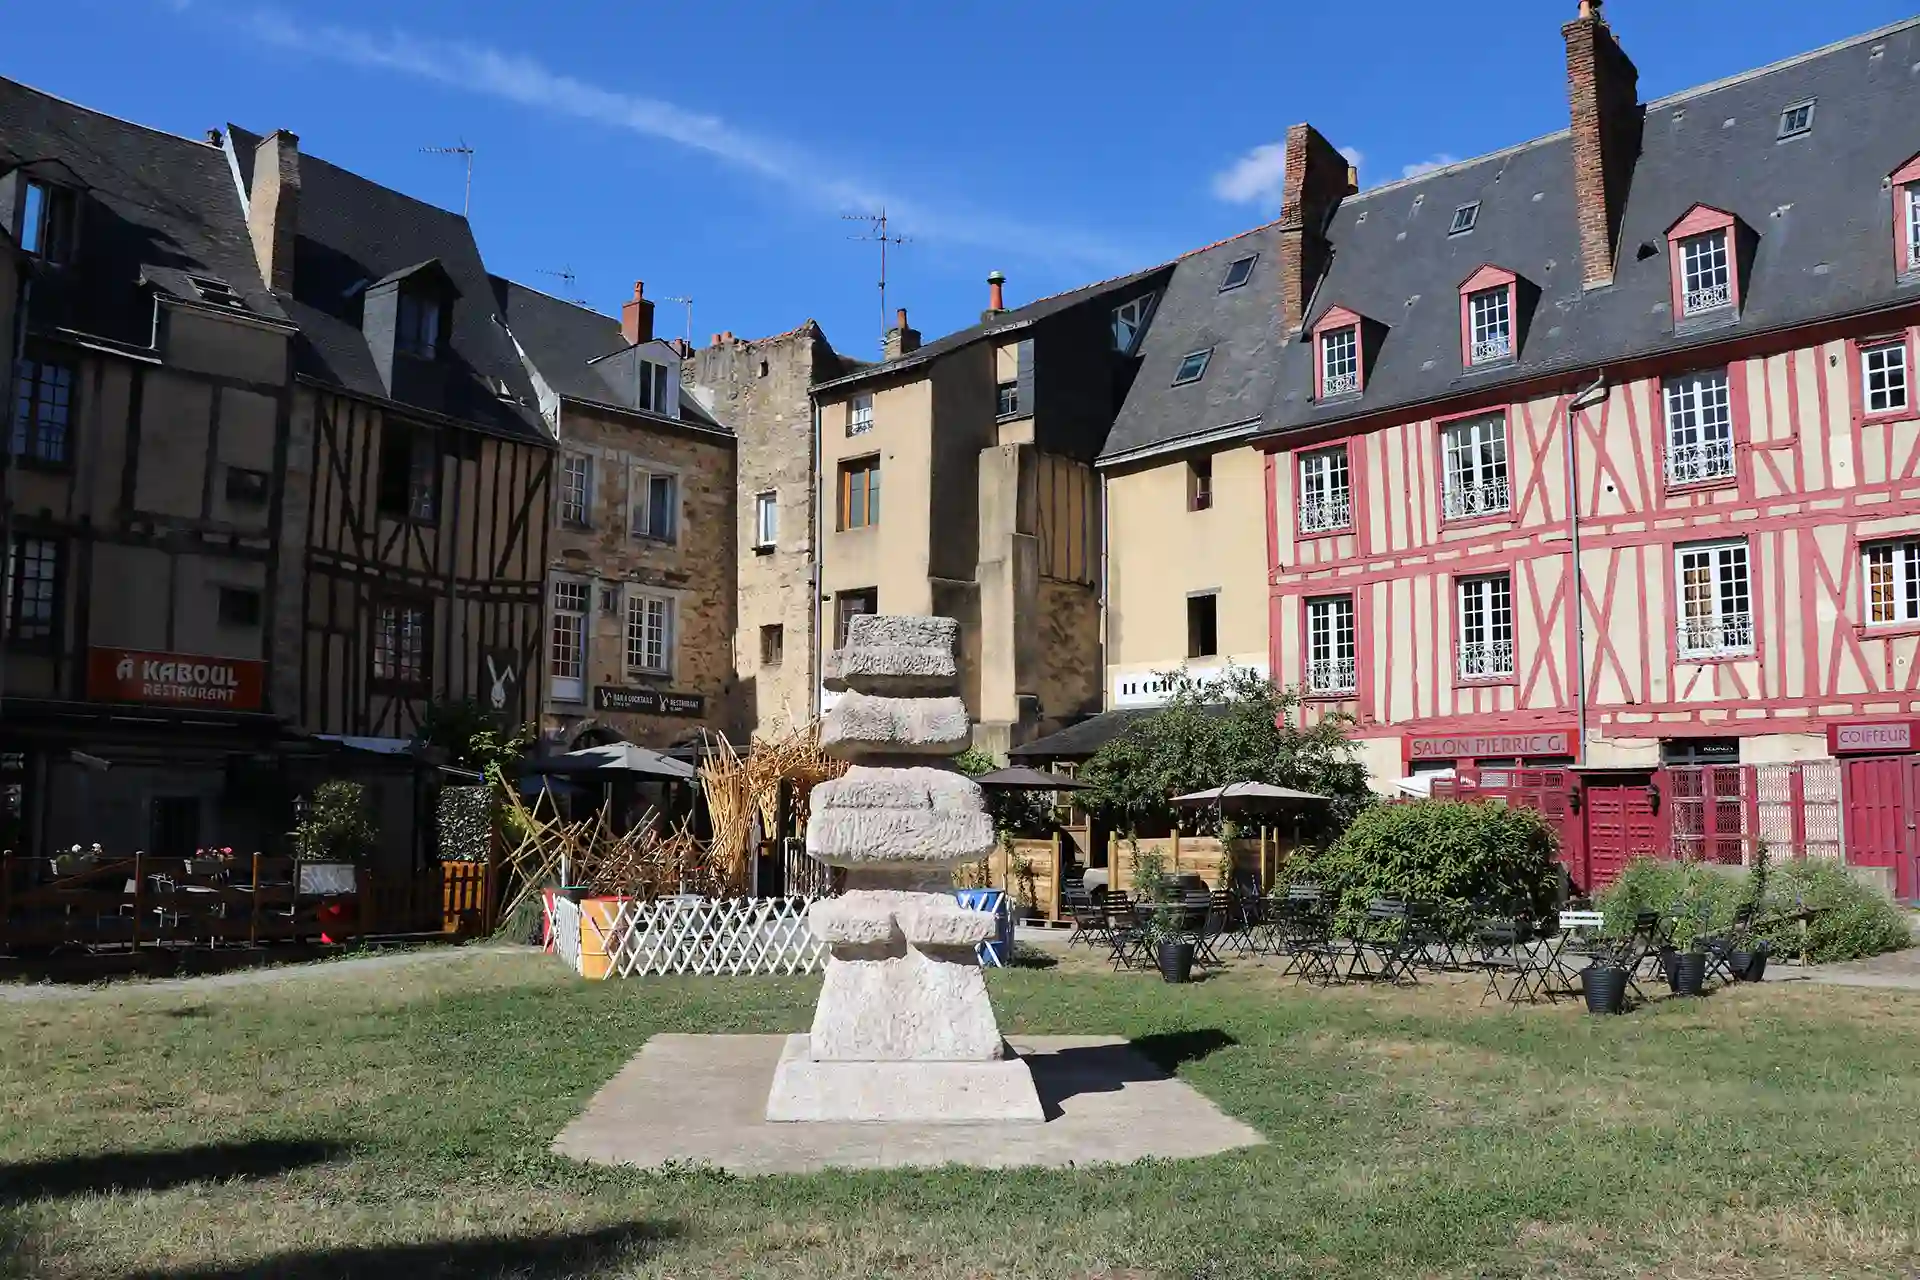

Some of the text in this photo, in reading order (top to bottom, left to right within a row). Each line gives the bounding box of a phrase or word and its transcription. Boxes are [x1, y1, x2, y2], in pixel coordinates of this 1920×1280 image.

[116, 653, 239, 687] À KABOUL
[143, 683, 236, 701] RESTAURANT
[628, 694, 653, 705] COCKTAILS
[670, 699, 699, 709] RESTAURANT
[1840, 729, 1908, 743] COIFFEUR
[1413, 738, 1470, 756] SALON
[1548, 735, 1565, 751] G.
